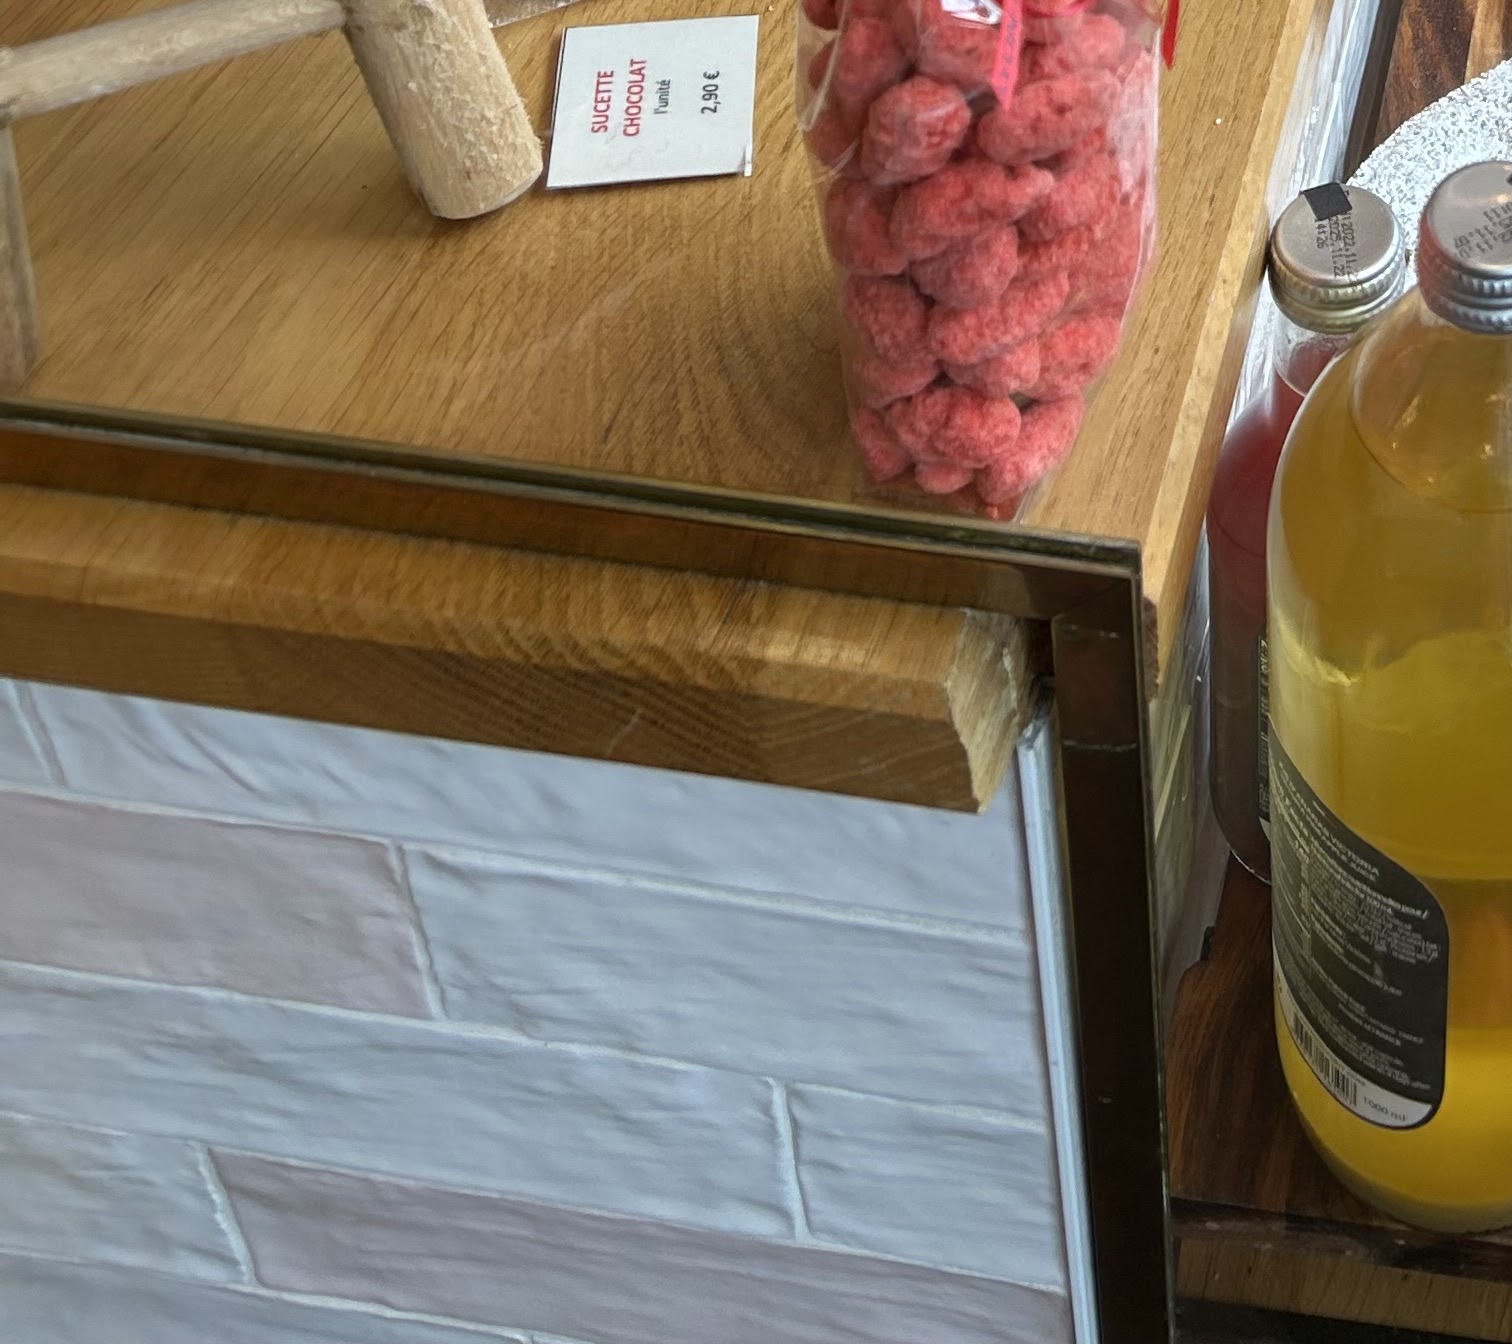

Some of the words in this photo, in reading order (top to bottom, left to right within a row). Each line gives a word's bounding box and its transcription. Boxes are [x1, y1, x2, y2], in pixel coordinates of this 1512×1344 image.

[706, 69, 722, 82] €
[591, 70, 615, 134] SUCETTE
[622, 58, 648, 137] CHOCOLAT
[653, 78, 672, 115] l'unité
[700, 84, 720, 115] 2,90
